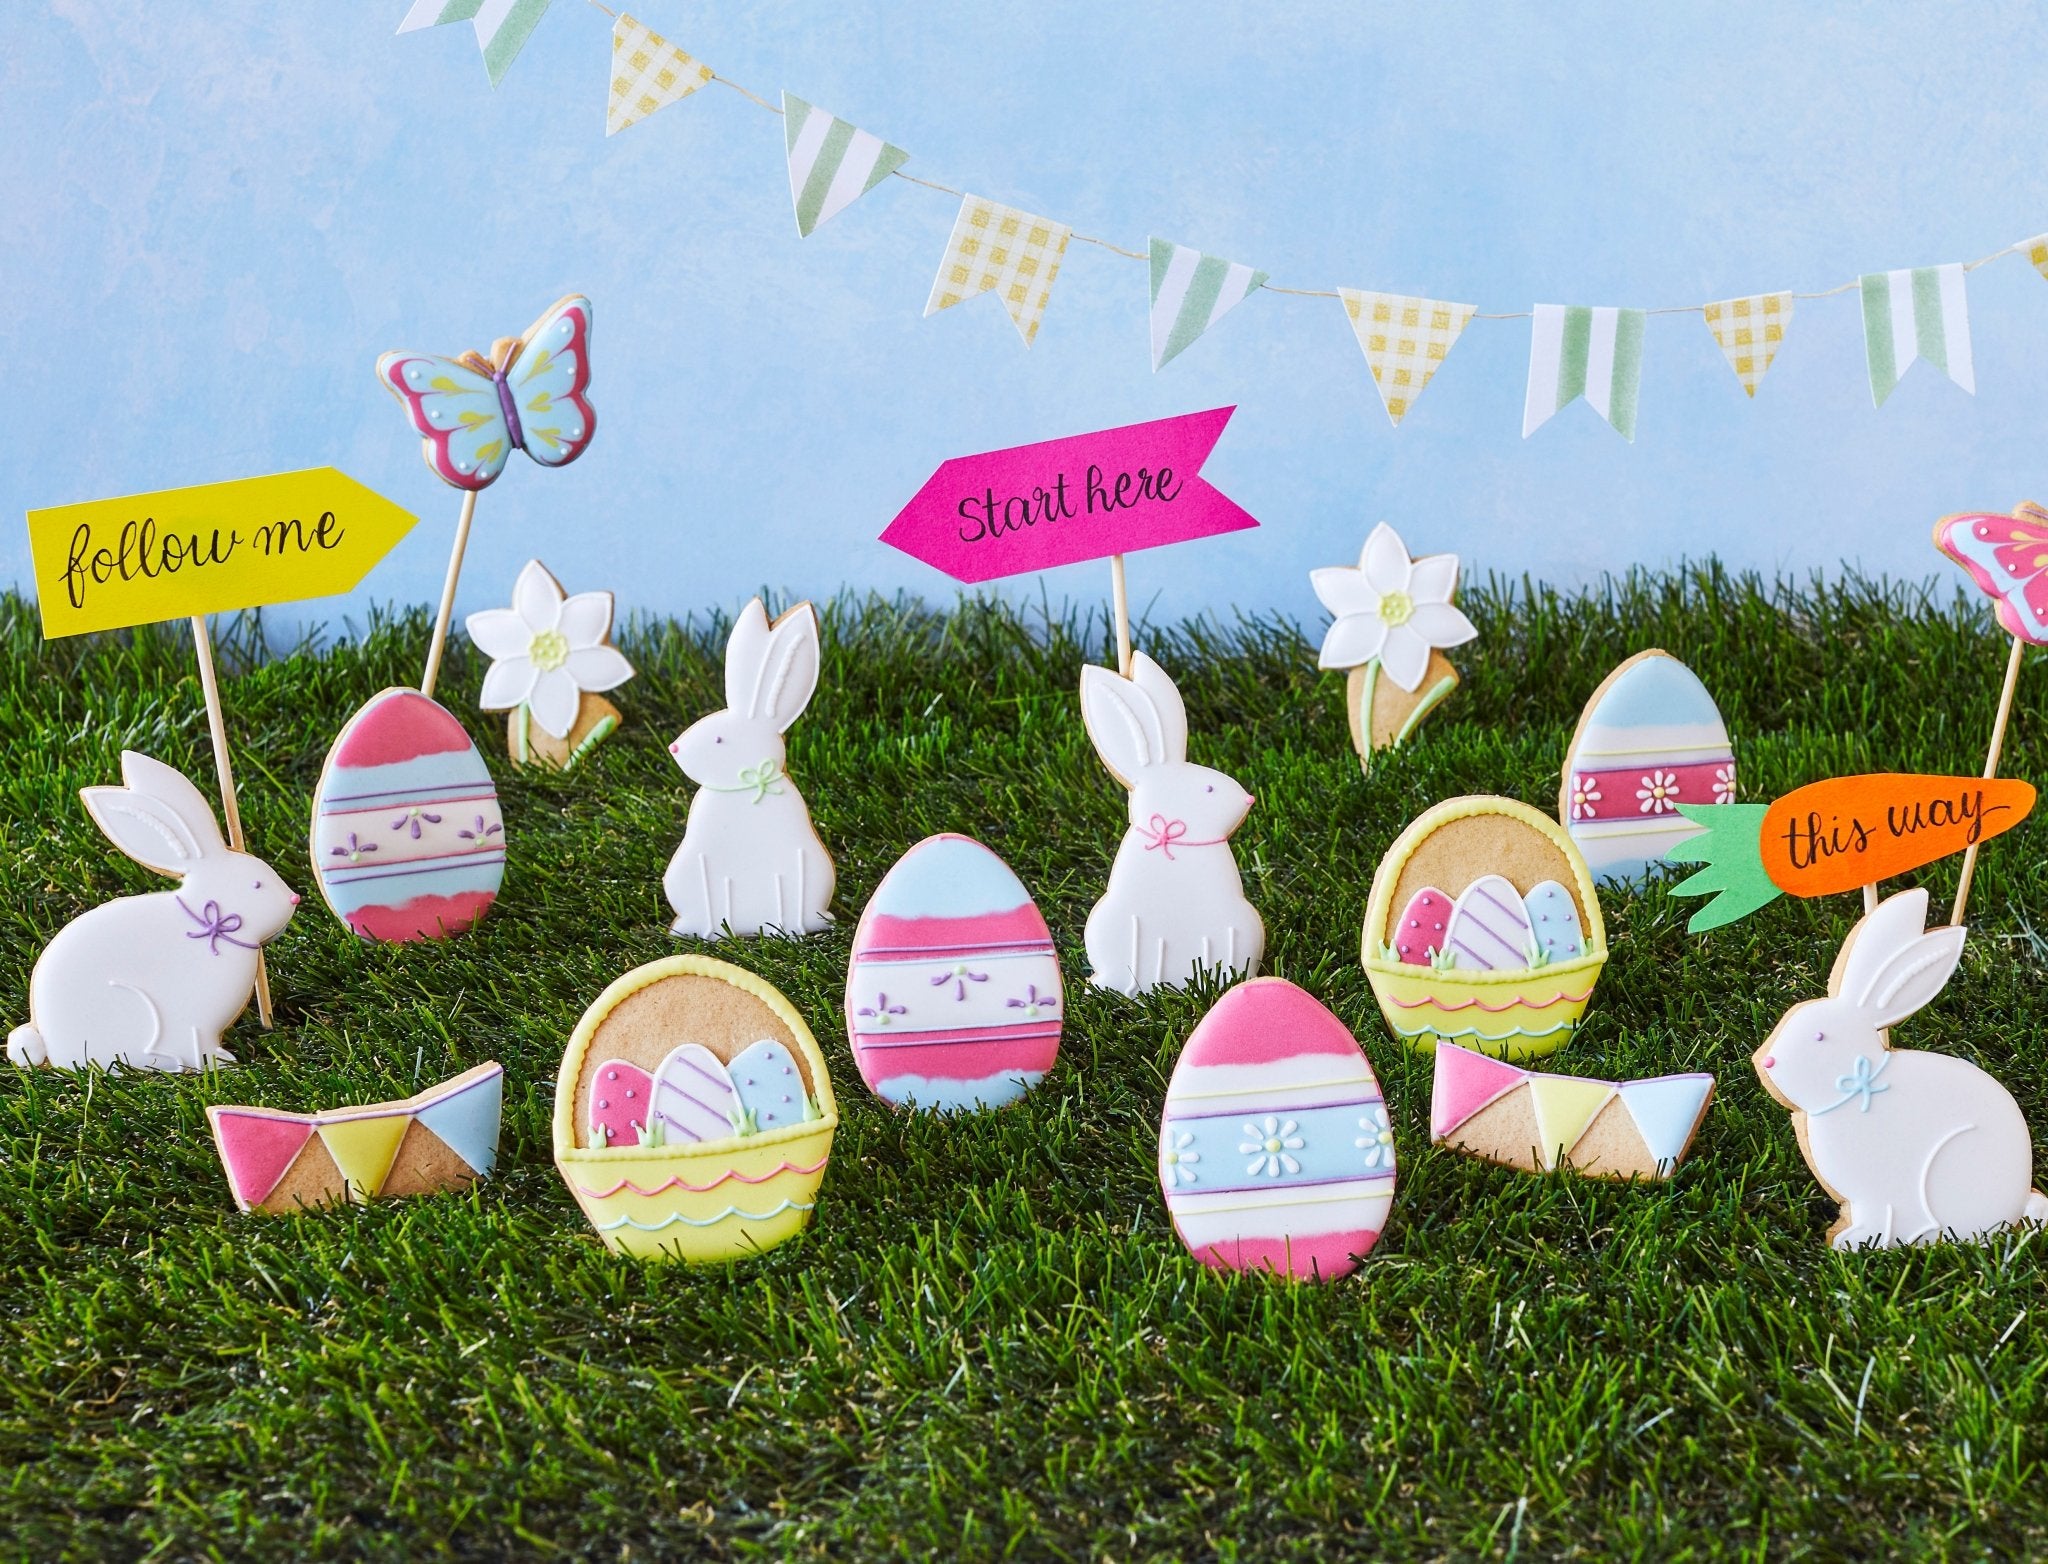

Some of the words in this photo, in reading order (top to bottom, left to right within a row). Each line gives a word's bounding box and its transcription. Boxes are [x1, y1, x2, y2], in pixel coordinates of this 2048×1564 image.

[1085, 464, 1184, 514] here
[58, 517, 244, 609] follow
[252, 510, 346, 556] me
[1780, 811, 1877, 870] this
[1886, 789, 2011, 845] way
